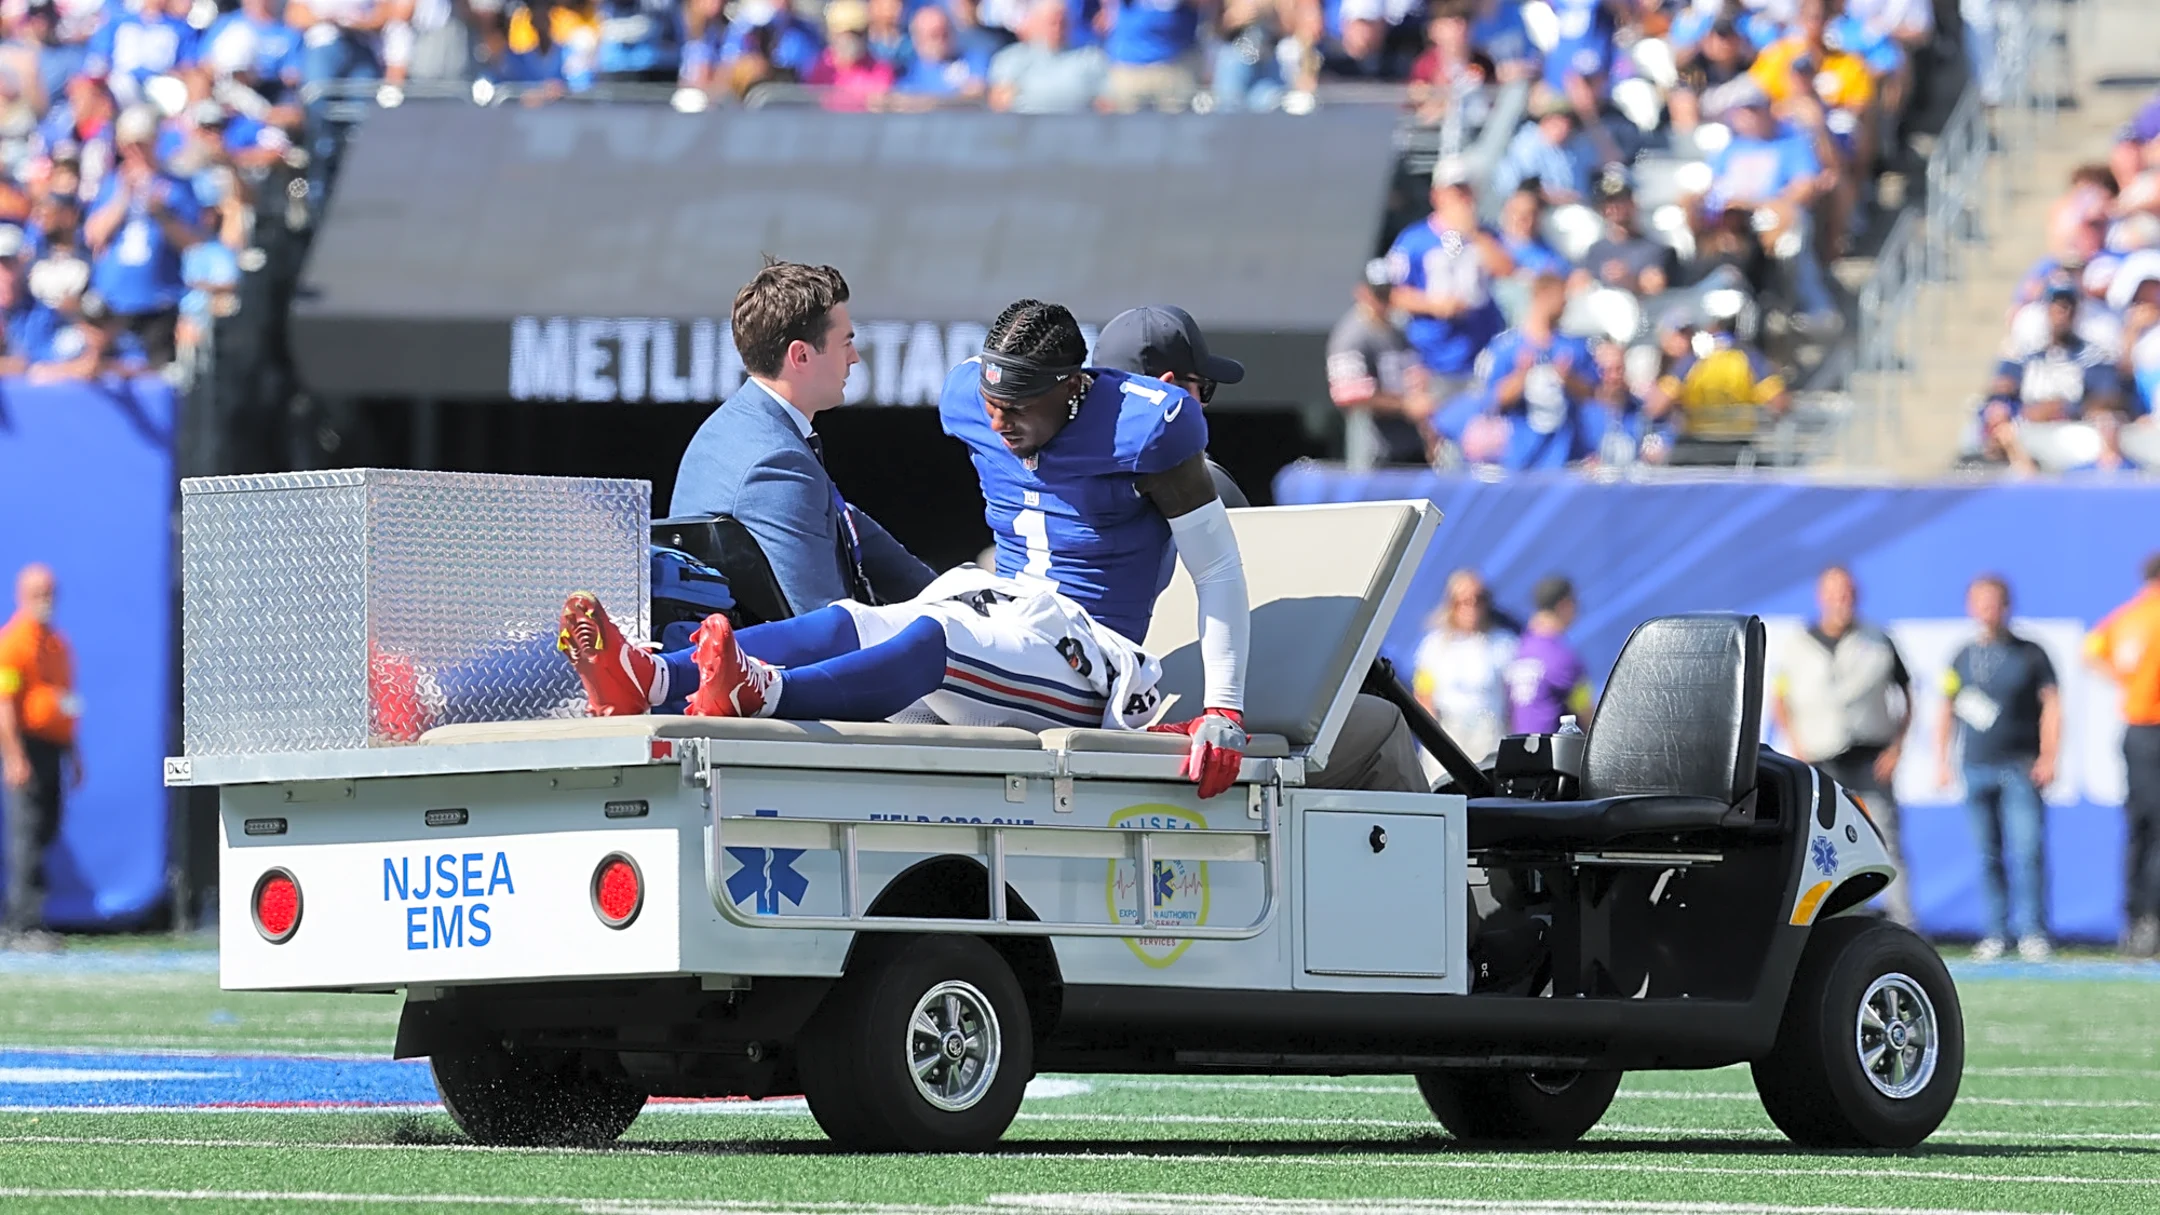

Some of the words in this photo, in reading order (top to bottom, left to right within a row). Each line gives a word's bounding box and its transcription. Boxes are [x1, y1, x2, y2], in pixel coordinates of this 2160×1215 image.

[509, 316, 746, 404] METLIF
[1120, 381, 1168, 406] 1
[1012, 508, 1061, 584] 1
[383, 852, 515, 901] NJSEA
[407, 903, 491, 951] EMS
[1160, 909, 1198, 920] AUTHORITY
[1139, 937, 1176, 947] SERVICES
